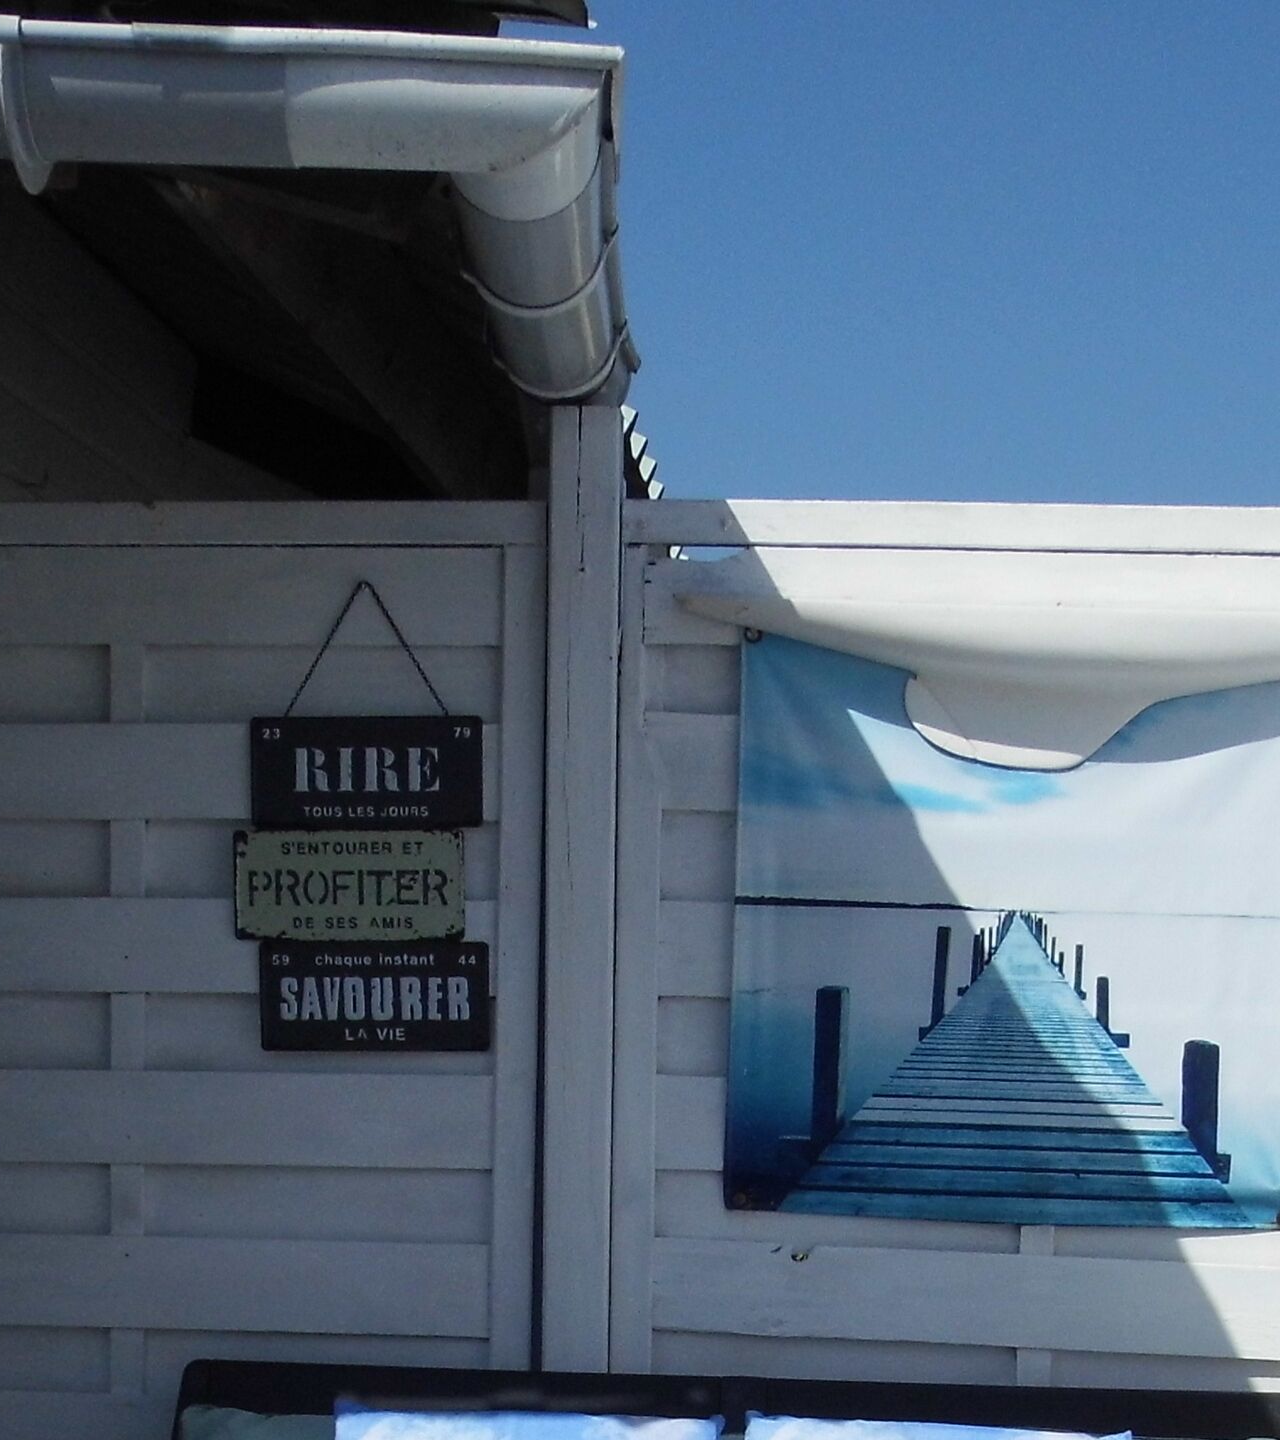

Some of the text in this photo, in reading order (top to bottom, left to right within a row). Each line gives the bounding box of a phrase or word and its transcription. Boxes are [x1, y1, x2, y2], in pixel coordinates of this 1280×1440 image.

[262, 728, 280, 739] 23
[453, 726, 470, 738] 79
[294, 747, 439, 792] RIRE
[304, 806, 428, 817] TOUS LES JOURS
[281, 841, 424, 855] S'ENTOURER ET
[248, 870, 448, 906] PROFITER
[293, 917, 414, 929] DE SES AMIS
[272, 955, 290, 966] 59
[315, 953, 434, 967] chaque instant
[458, 954, 477, 965] 44
[280, 976, 470, 1021] SAVOURER
[345, 1028, 406, 1041] LA VIE
